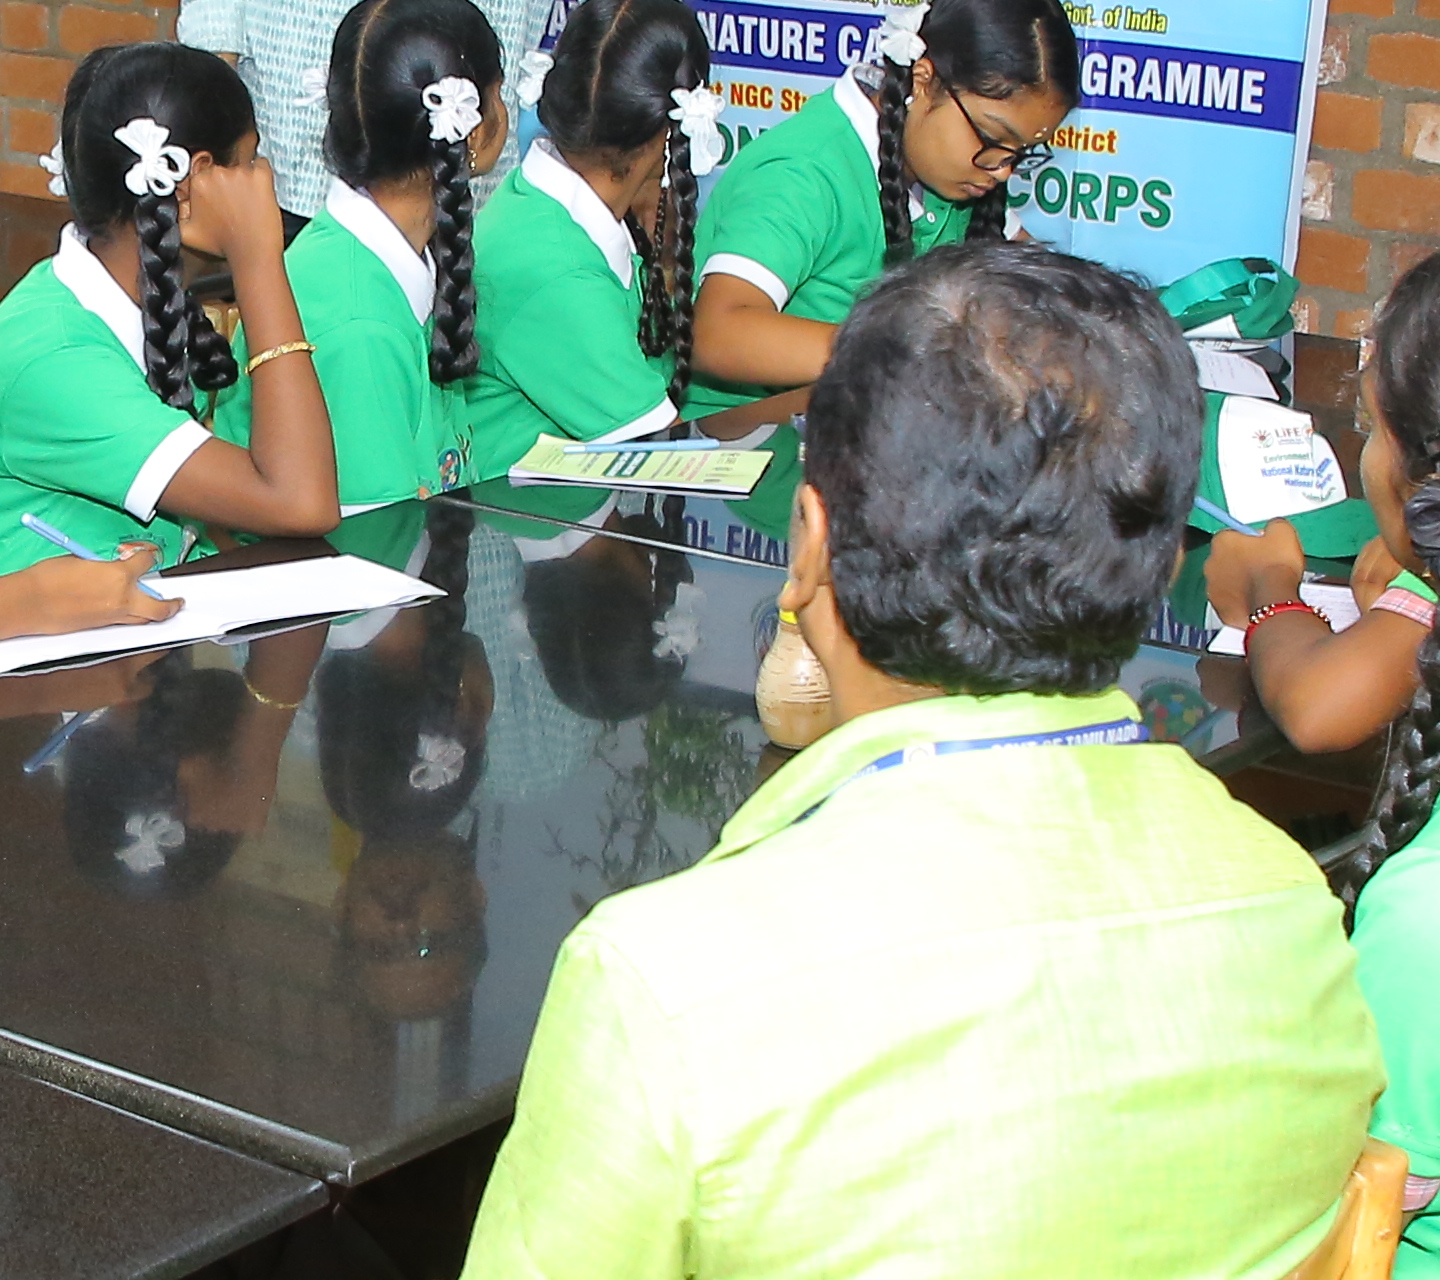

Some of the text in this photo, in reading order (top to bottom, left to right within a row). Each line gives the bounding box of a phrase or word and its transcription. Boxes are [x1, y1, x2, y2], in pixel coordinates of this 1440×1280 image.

[1104, 6, 1123, 30] of
[1125, 7, 1168, 33] India
[696, 10, 827, 64] NATURE
[730, 83, 774, 110] NGC
